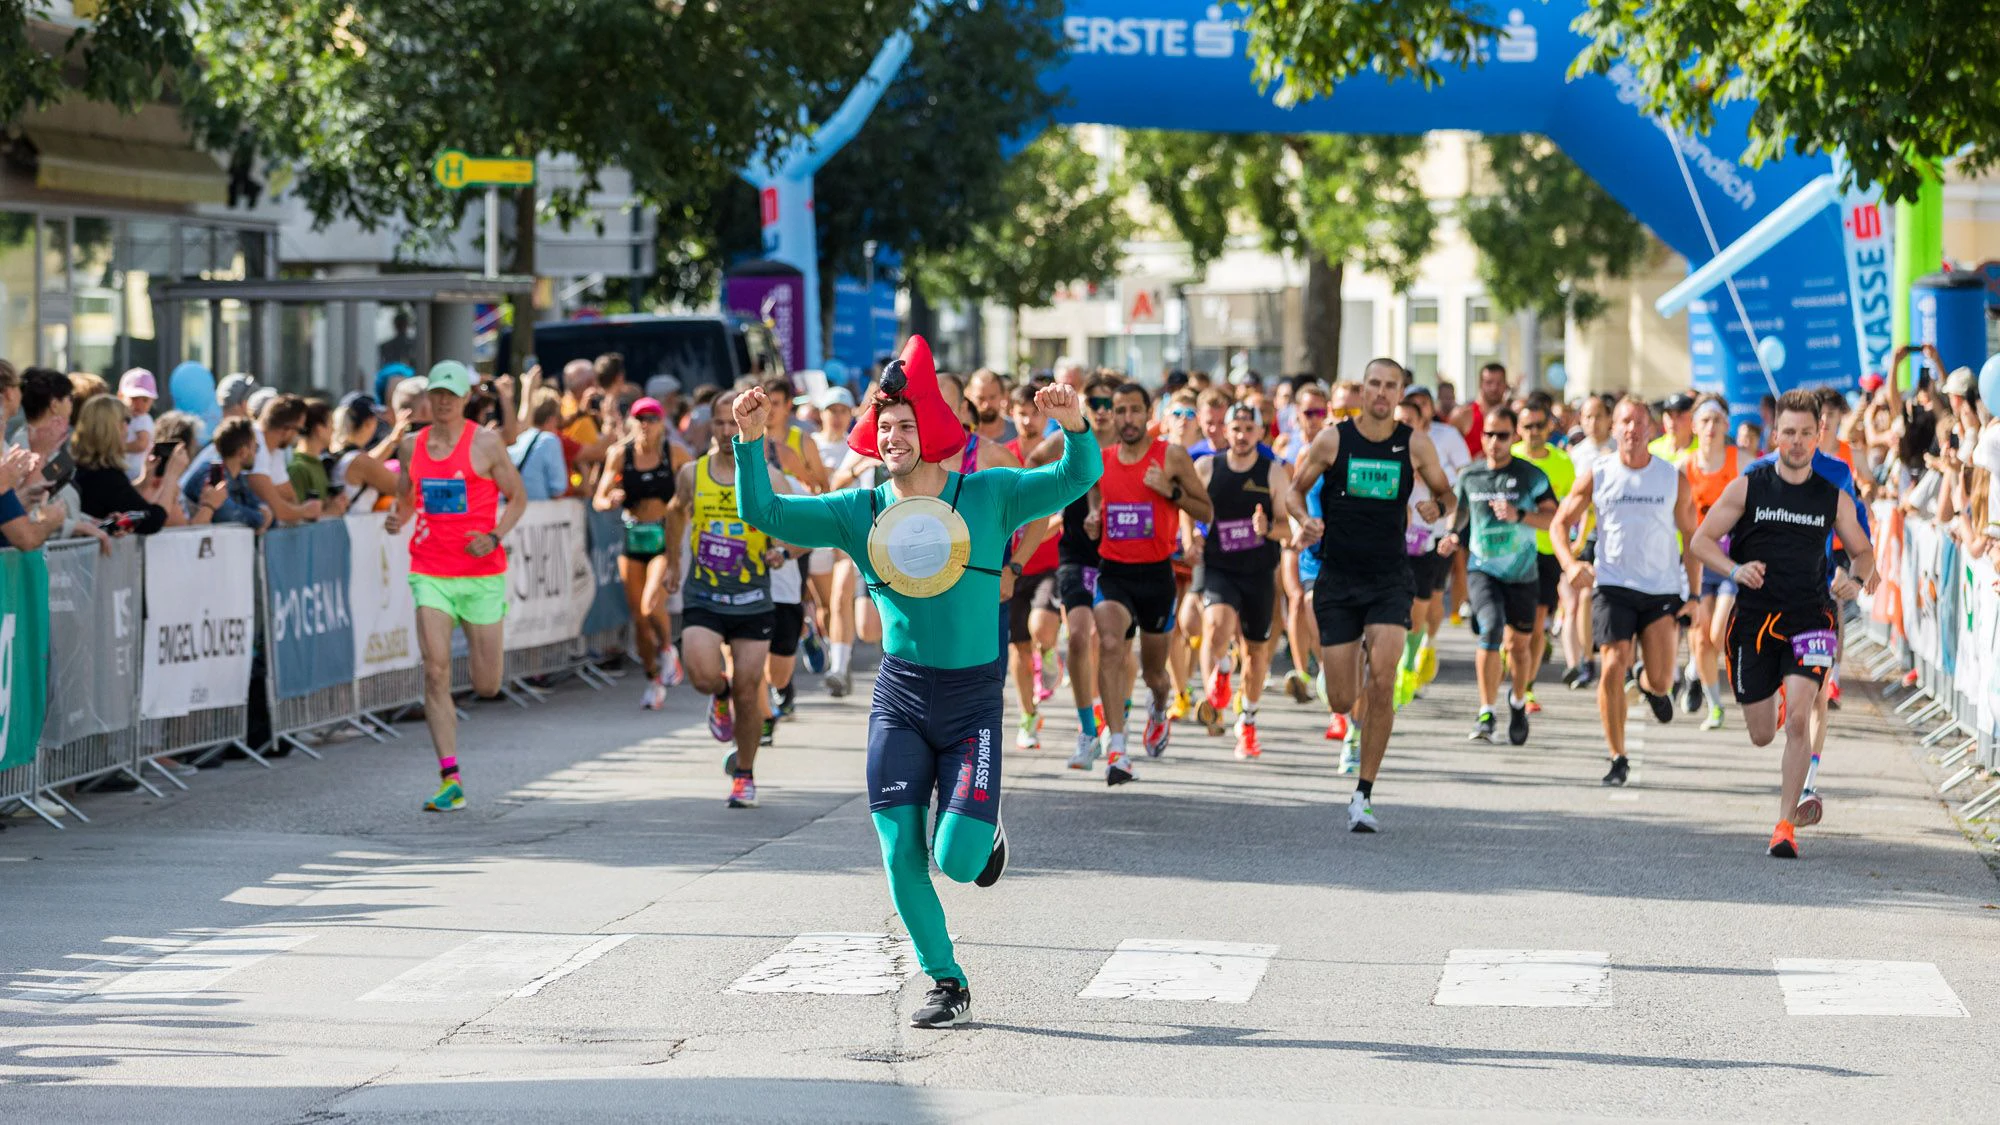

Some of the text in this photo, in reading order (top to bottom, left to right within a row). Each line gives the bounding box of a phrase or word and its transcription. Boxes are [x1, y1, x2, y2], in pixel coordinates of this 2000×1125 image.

[1063, 16, 1187, 57] ERSTE
[444, 159, 464, 181] H
[1361, 471, 1387, 483] 1194
[1754, 506, 1825, 528] joinfitness.at
[975, 728, 991, 790] SPARKASSE
[881, 785, 901, 793] JAKO
